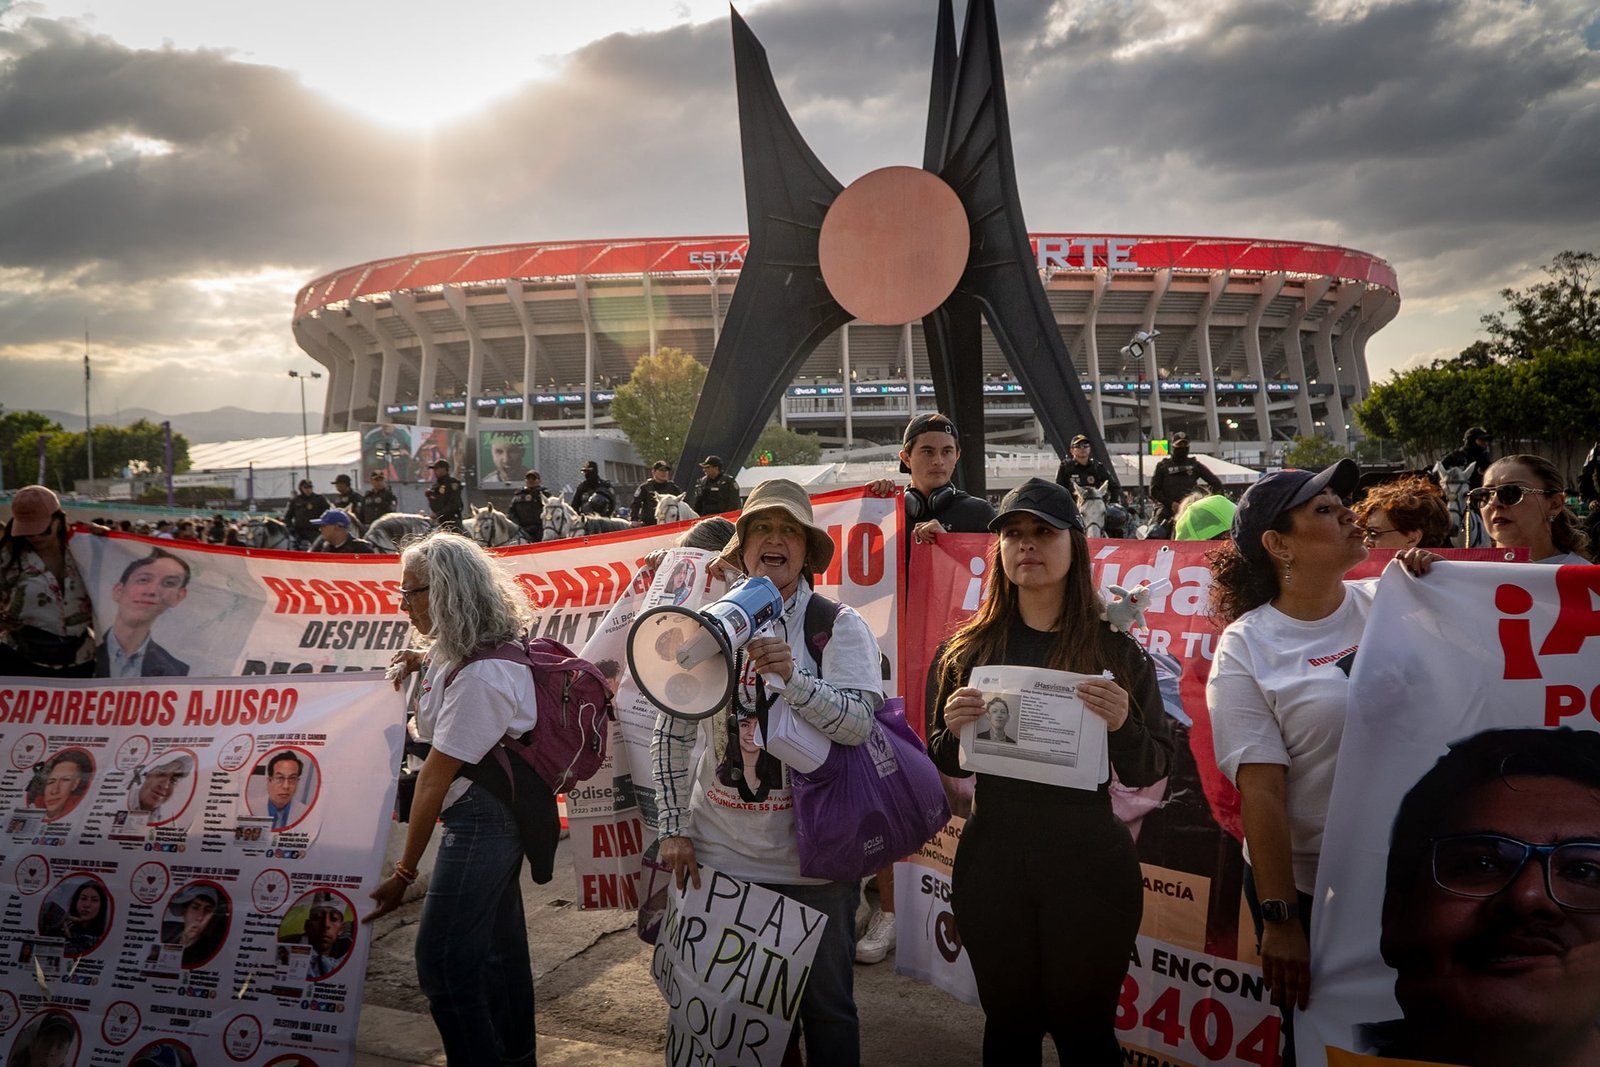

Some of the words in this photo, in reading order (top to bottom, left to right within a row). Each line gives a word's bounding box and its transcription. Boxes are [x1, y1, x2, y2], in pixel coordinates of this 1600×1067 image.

[689, 250, 748, 264] ESTA
[1037, 237, 1138, 269] RTE
[814, 523, 885, 587] IO
[183, 687, 299, 727] AJUSCO
[1544, 684, 1600, 727] P
[704, 870, 824, 956] PLAY
[704, 927, 809, 1021] PAIN
[686, 996, 769, 1067] OUR
